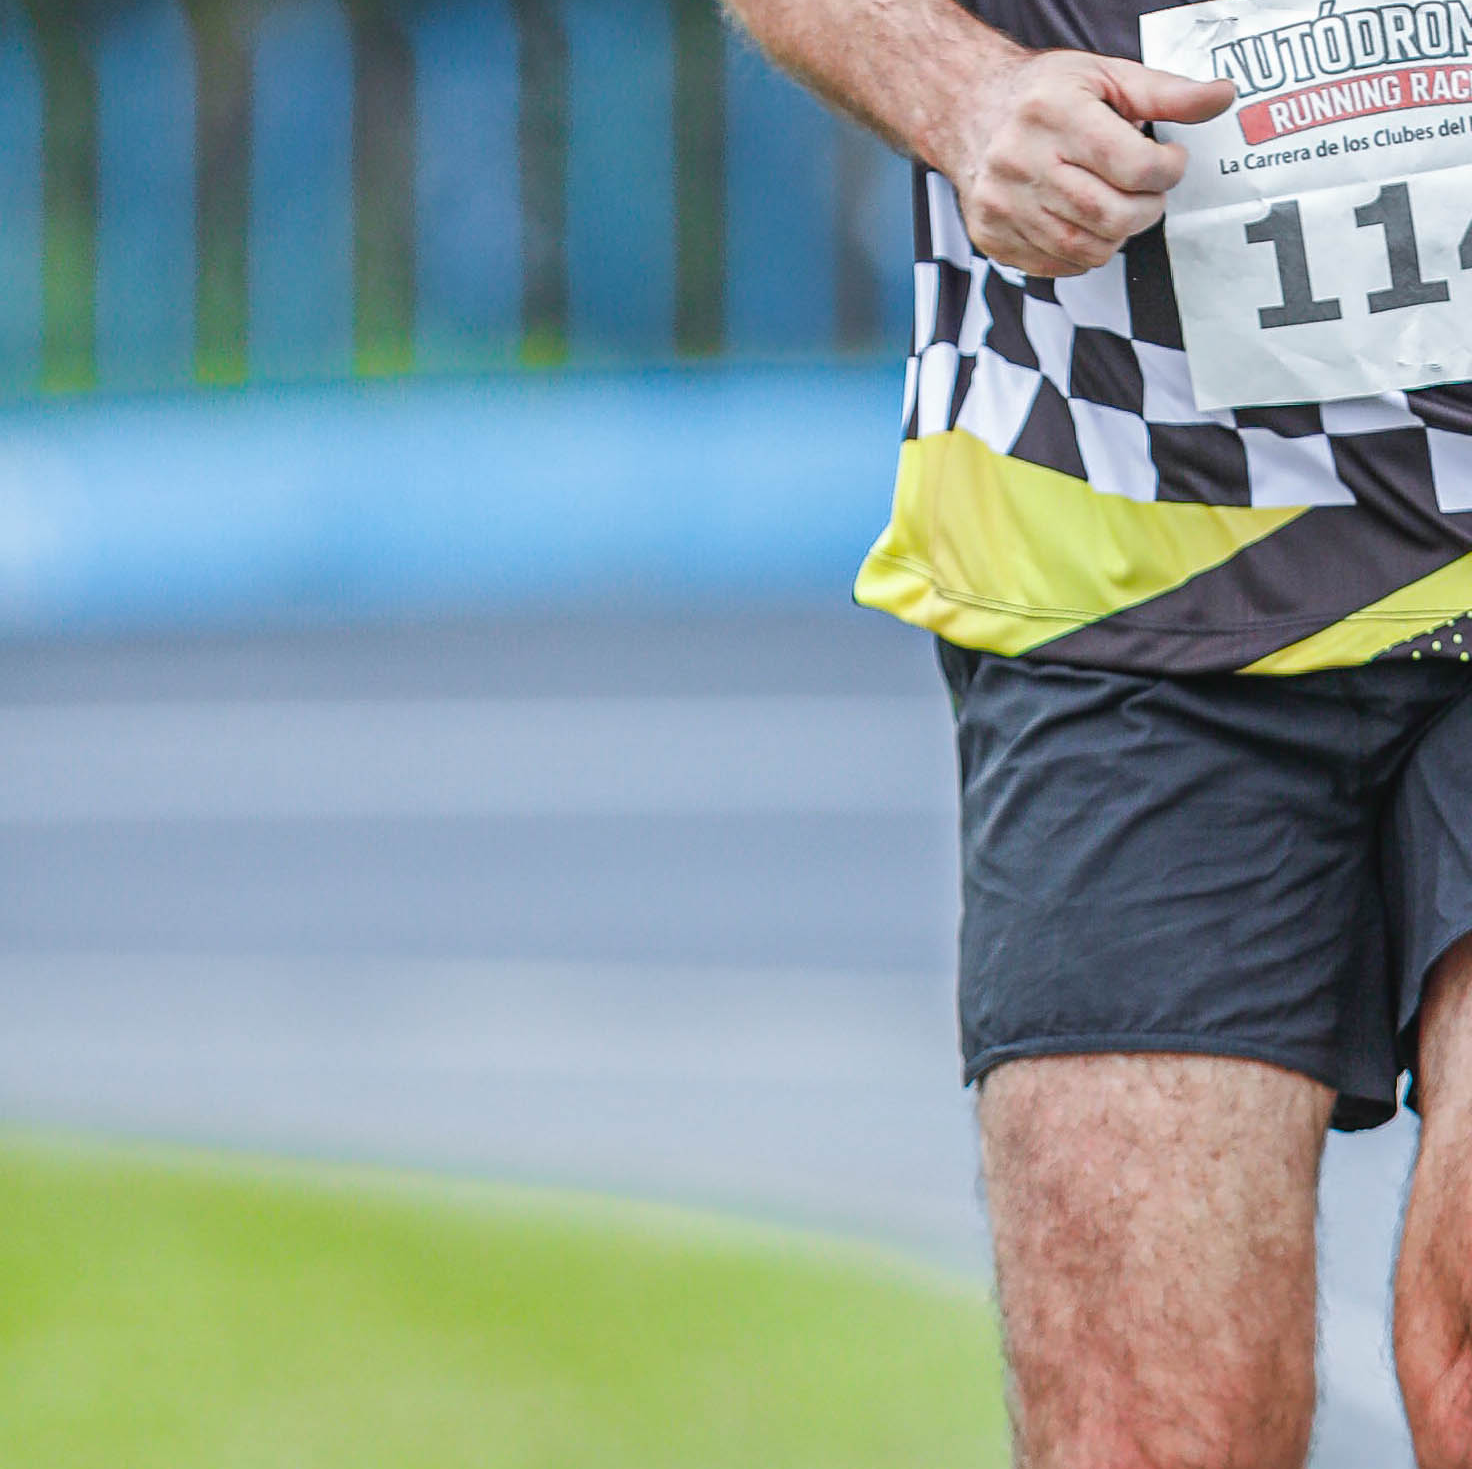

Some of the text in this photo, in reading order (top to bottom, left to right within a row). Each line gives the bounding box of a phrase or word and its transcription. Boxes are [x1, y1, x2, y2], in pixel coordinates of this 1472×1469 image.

[1269, 75, 1401, 134] RUNNING
[1219, 158, 1239, 175] La
[1244, 148, 1311, 170] Carrera
[1316, 140, 1339, 158] de
[1343, 134, 1369, 153] los
[1374, 126, 1434, 147] Clubes
[1438, 120, 1465, 138] del
